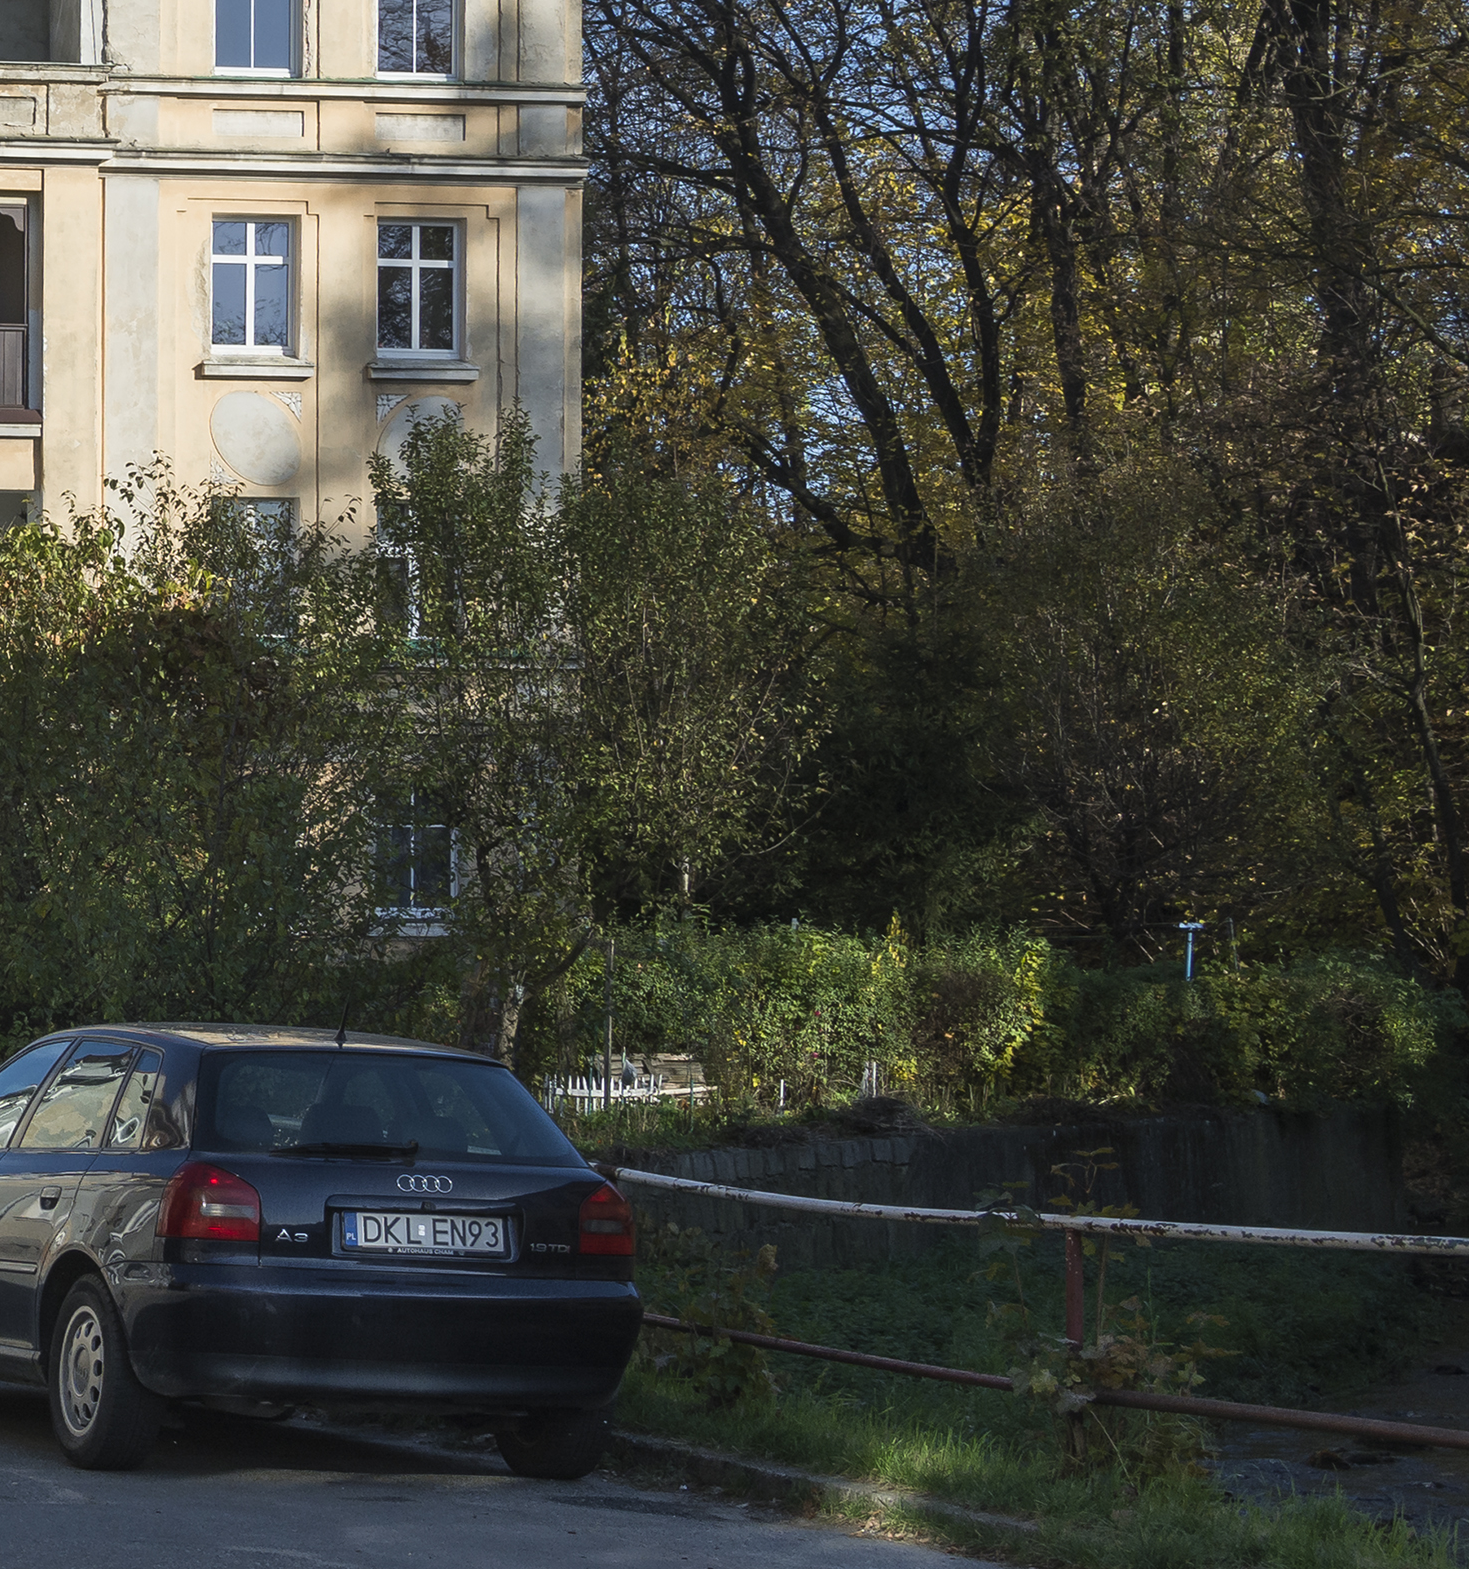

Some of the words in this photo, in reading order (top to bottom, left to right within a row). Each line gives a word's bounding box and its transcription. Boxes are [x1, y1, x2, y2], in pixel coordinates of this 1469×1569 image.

[275, 1228, 309, 1243] A3
[346, 1232, 357, 1241] PL
[363, 1215, 422, 1245] DKL
[431, 1217, 499, 1248] EN93
[396, 1247, 433, 1255] AUTOHAUS
[548, 1243, 571, 1254] TDI
